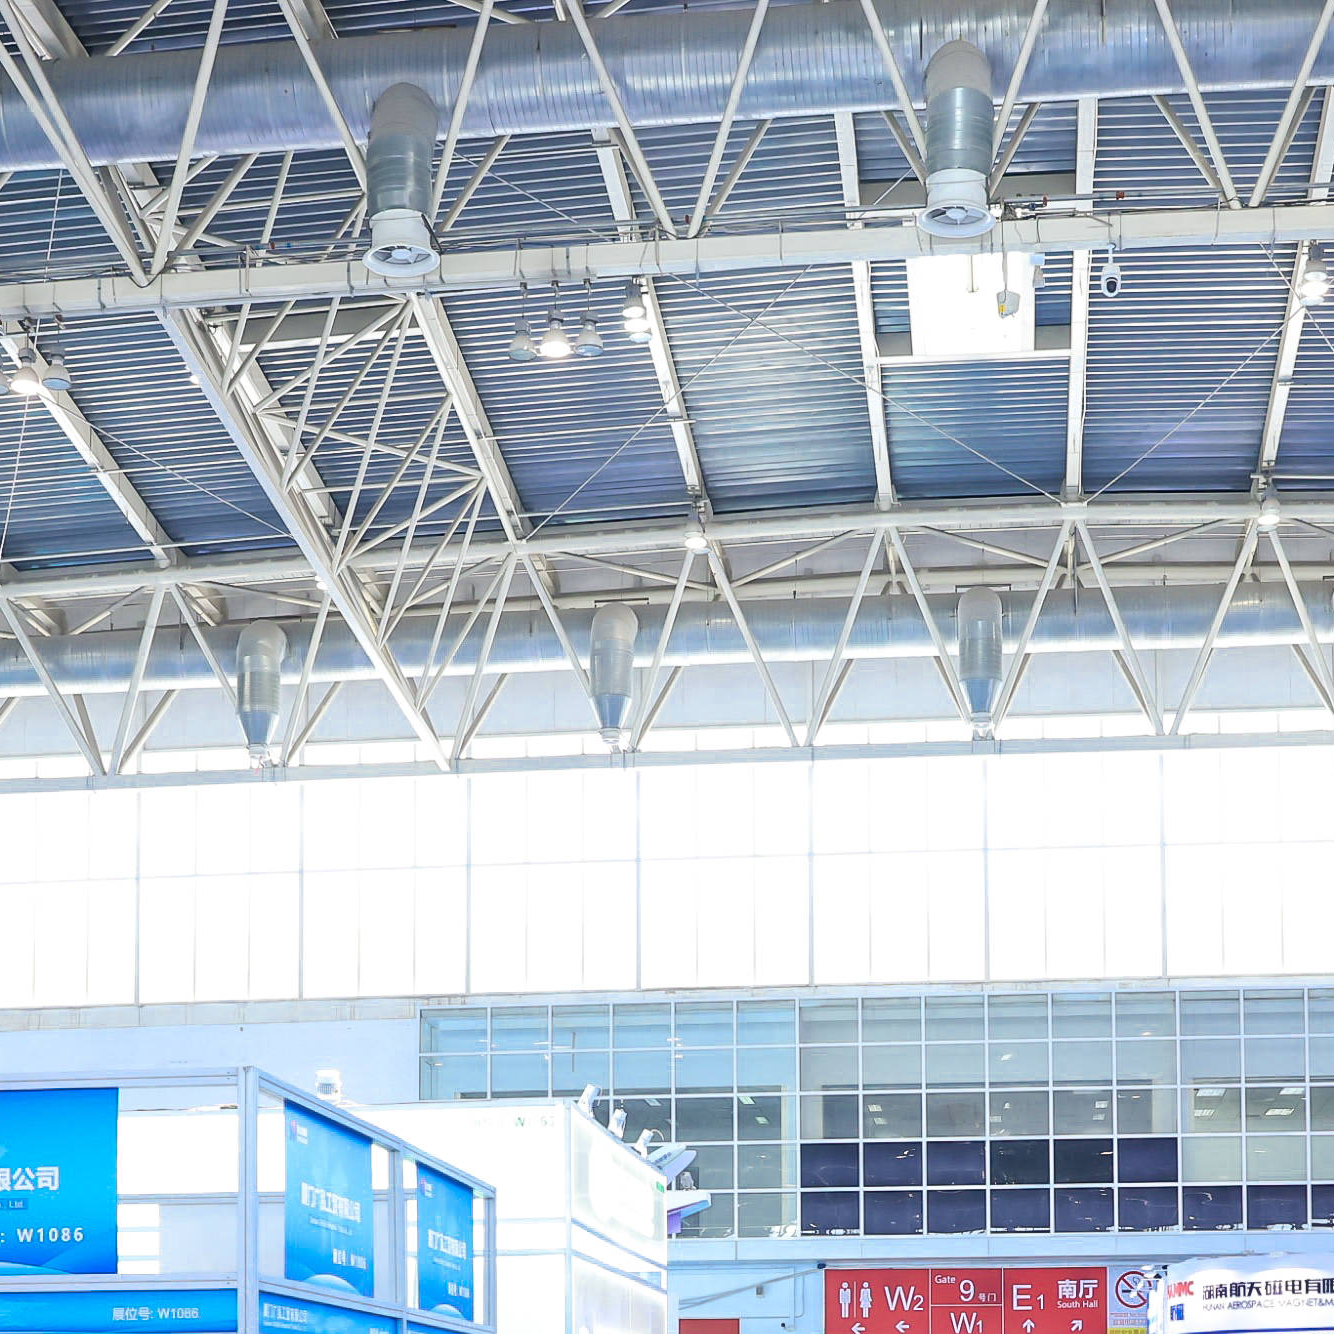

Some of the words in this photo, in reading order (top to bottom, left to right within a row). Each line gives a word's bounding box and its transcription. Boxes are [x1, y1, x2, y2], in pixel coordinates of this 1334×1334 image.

[17, 1227, 84, 1242] W1086
[934, 1275, 956, 1284] Gate
[959, 1280, 975, 1302] 9
[1057, 1279, 1099, 1299] 南厅
[884, 1286, 924, 1311] W2
[1057, 1300, 1080, 1309] South
[1082, 1300, 1099, 1308] Hall
[1227, 1299, 1275, 1309] AEROSPACE
[157, 1307, 200, 1320] W1086
[950, 1312, 983, 1334] W1
